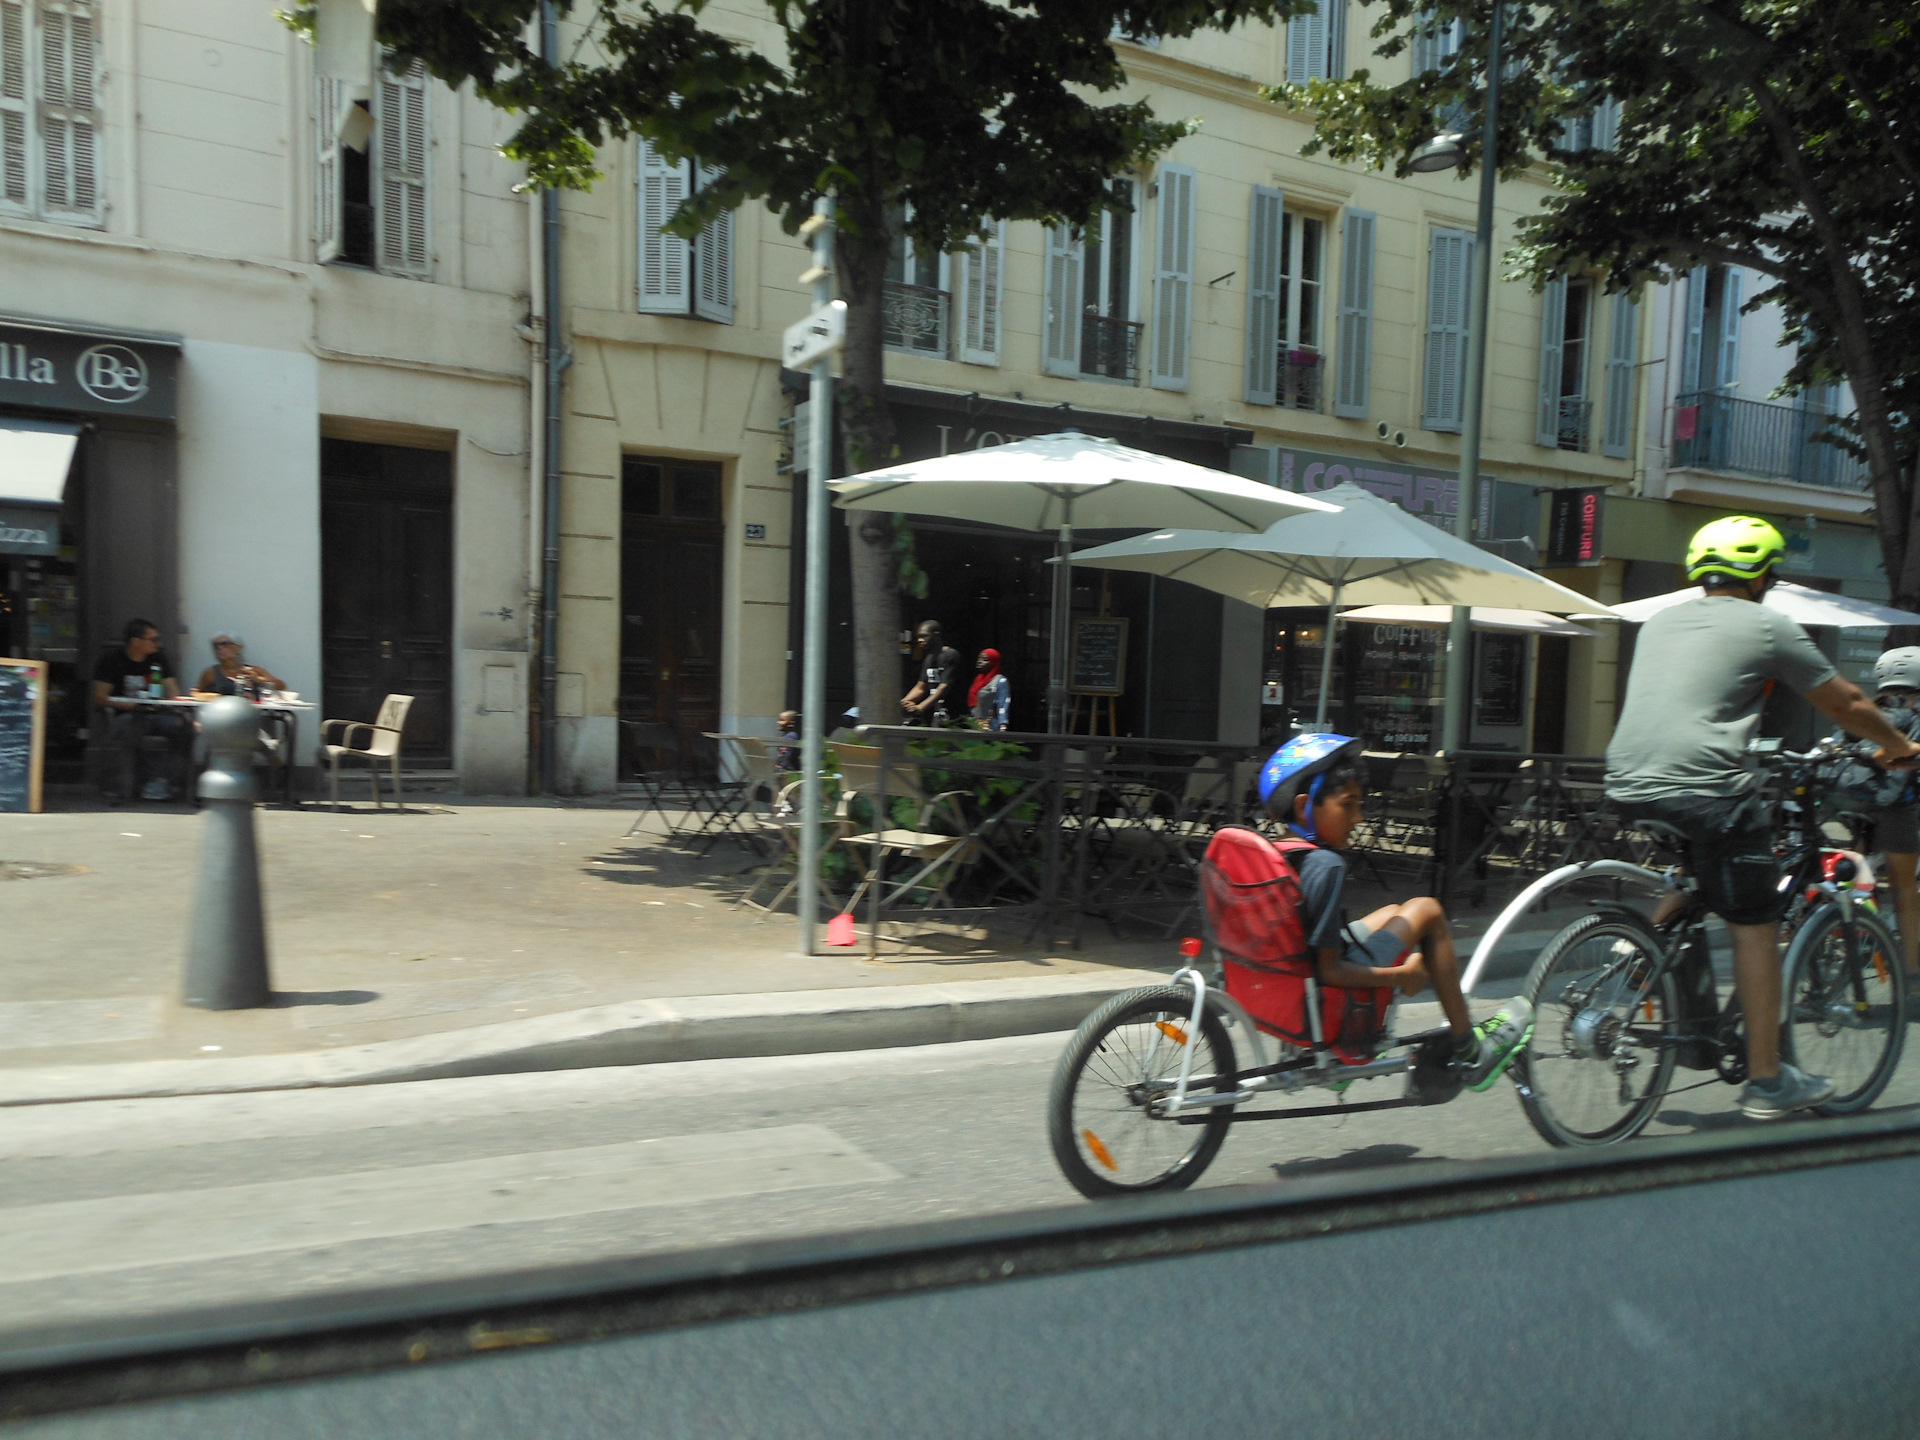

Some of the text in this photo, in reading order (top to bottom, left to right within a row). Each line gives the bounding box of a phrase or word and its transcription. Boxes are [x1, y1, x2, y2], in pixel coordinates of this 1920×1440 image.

[87, 351, 147, 391] Be
[1579, 494, 1597, 559] COIFFURE
[1383, 733, 1393, 742] de
